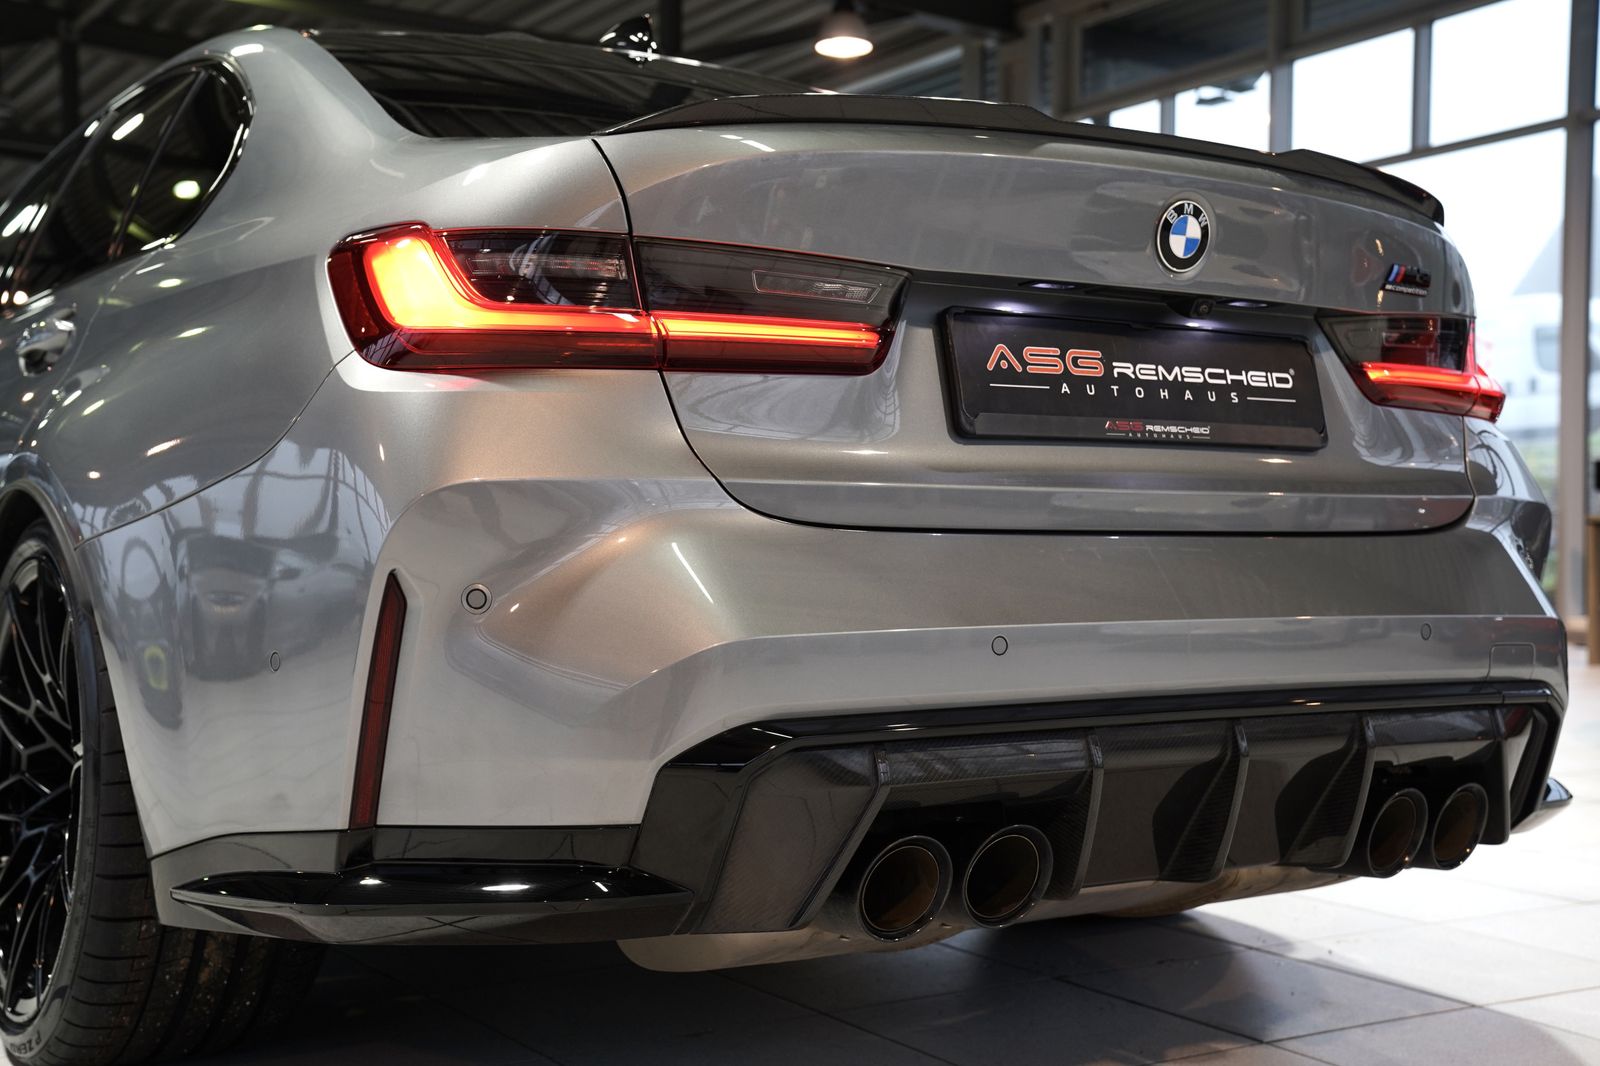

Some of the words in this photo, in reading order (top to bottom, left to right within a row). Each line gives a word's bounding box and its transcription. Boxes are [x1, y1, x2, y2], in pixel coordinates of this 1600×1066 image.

[1166, 203, 1208, 228] BMW
[986, 344, 1104, 377] ASG
[1060, 383, 1239, 403] AUTOHAUS
[1105, 420, 1144, 432] ASG
